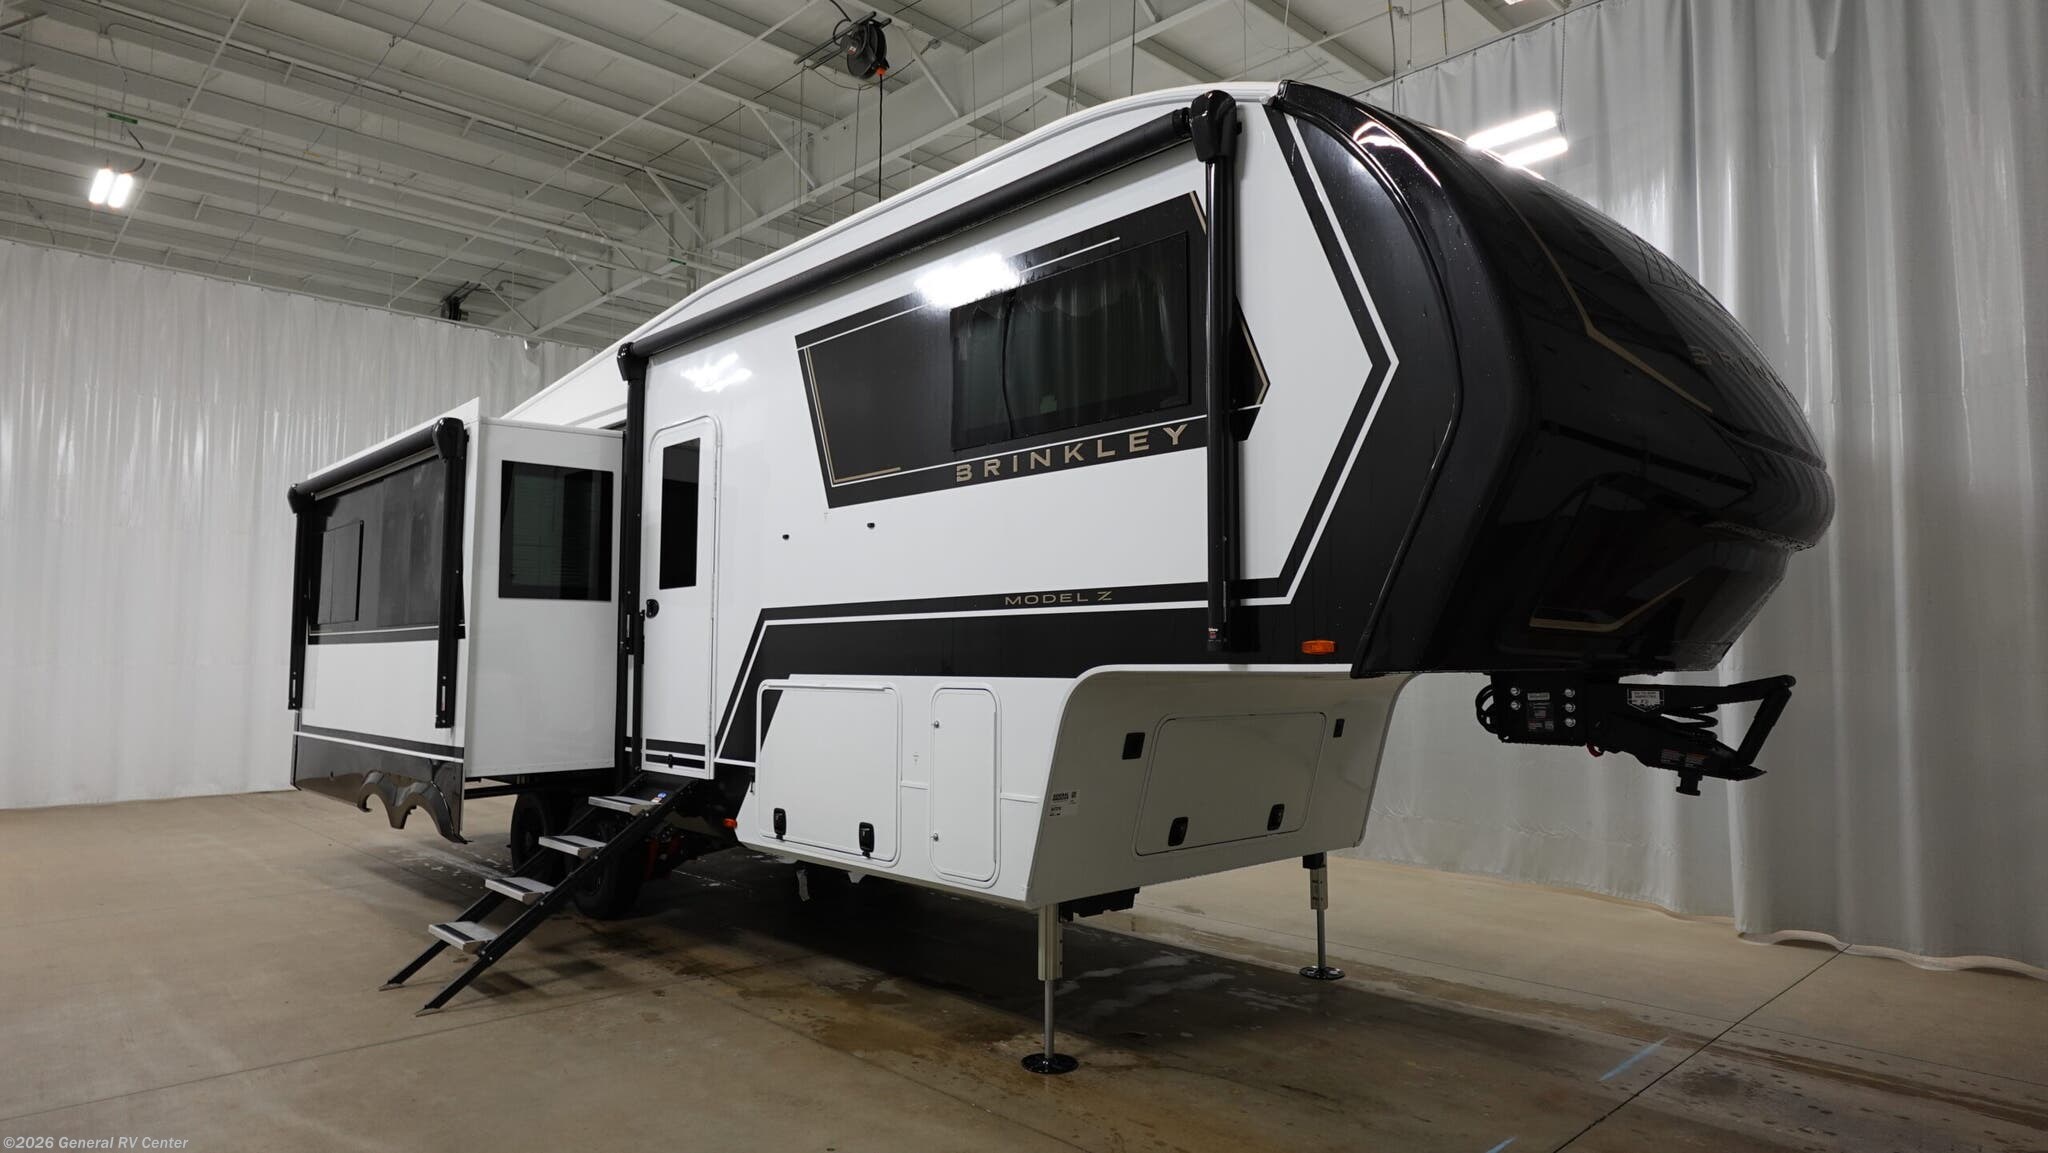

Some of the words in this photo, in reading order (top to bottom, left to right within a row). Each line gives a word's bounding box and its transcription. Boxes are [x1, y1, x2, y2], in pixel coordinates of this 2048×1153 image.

[956, 424, 1188, 483] BRINKLEY
[1005, 592, 1089, 606] MODEL
[1097, 590, 1113, 601] Z
